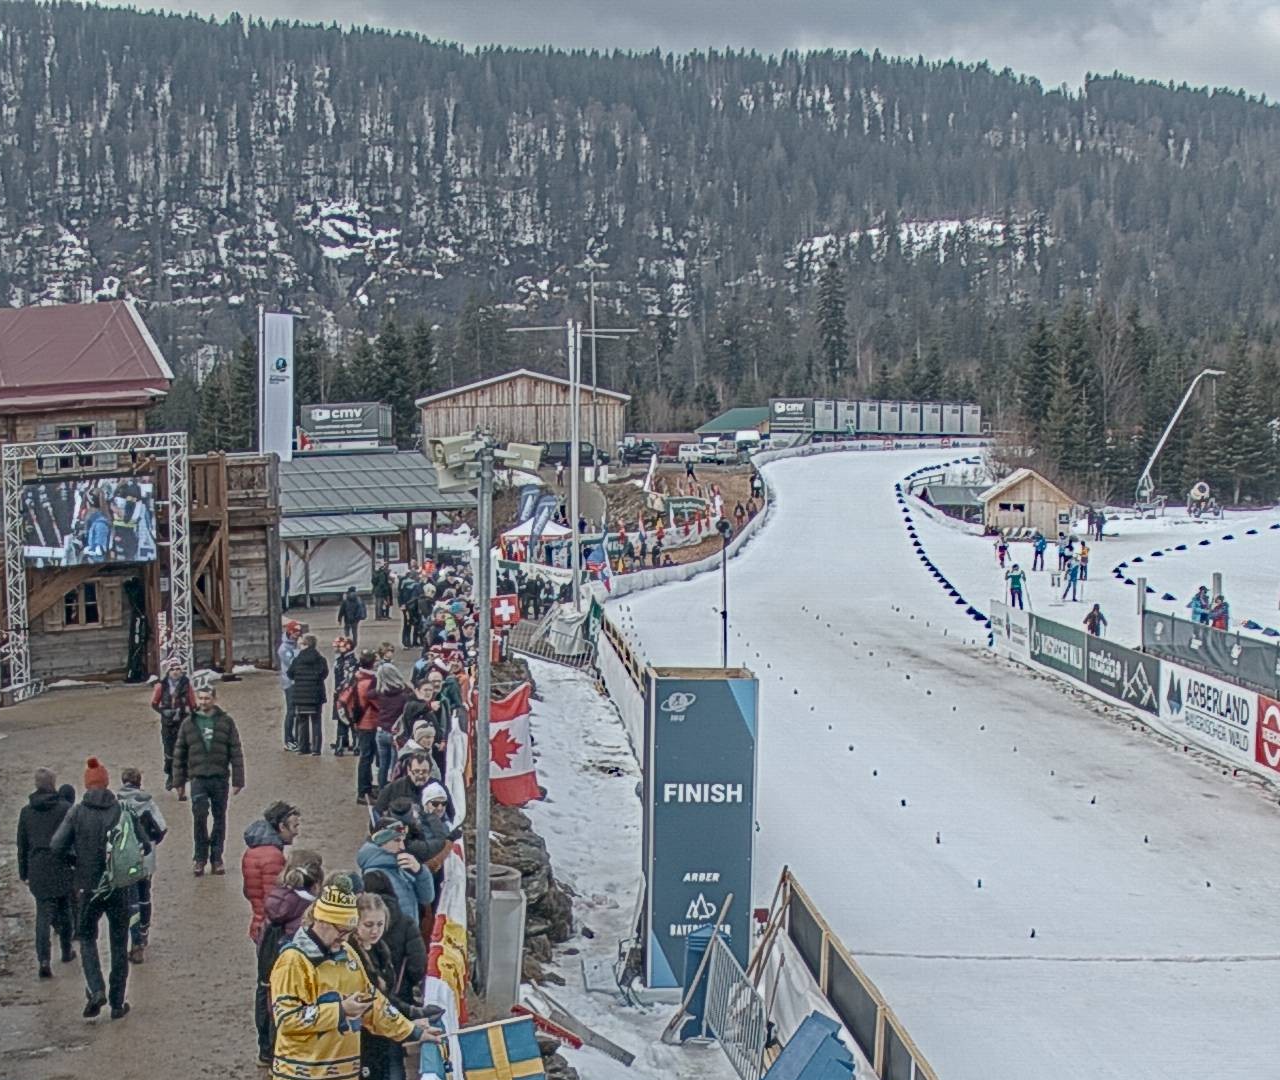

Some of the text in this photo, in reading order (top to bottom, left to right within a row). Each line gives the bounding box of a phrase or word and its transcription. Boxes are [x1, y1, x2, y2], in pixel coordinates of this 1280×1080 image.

[331, 407, 363, 419] cmv
[1185, 677, 1250, 726] ARBERLAND
[663, 782, 744, 804] FINISH
[682, 871, 721, 883] ARBER
